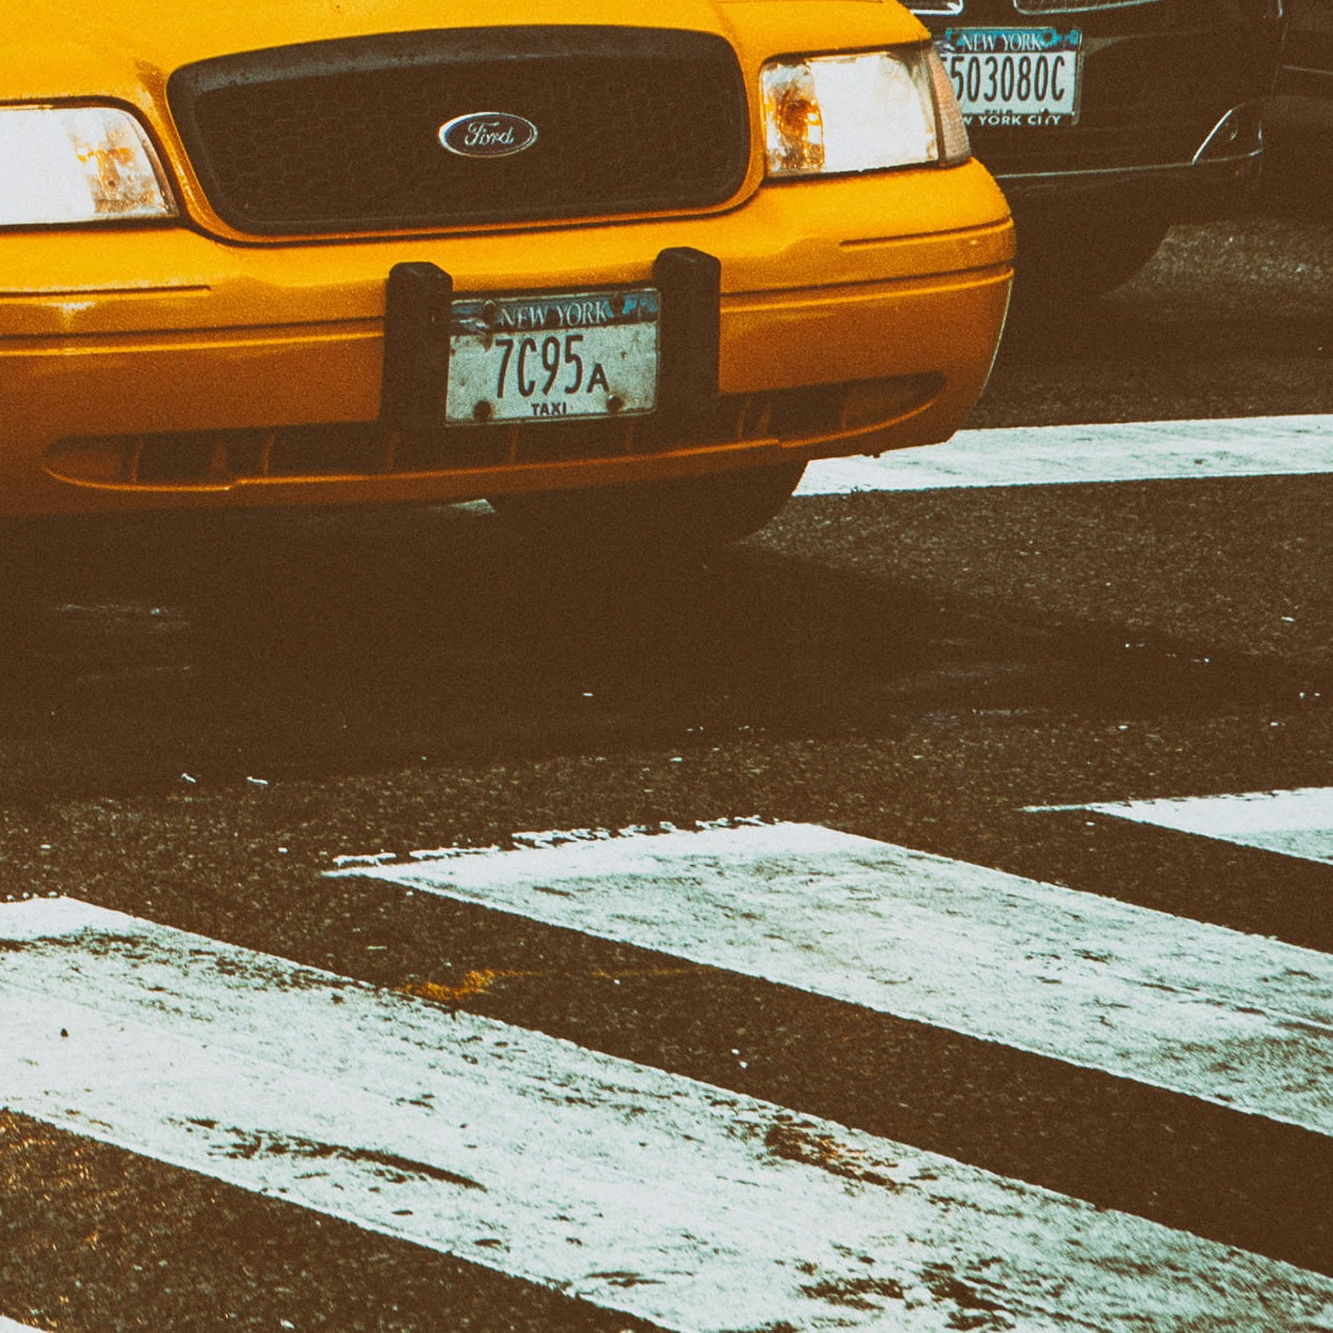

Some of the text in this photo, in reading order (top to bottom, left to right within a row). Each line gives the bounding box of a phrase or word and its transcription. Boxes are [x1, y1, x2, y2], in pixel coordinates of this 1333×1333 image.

[961, 33, 1044, 52] NEW YORK
[943, 55, 1065, 102] 503080C
[978, 115, 1022, 126] YORK
[464, 122, 514, 146] Ford
[500, 298, 608, 330] NEW YORK
[531, 401, 568, 416] TAXI
